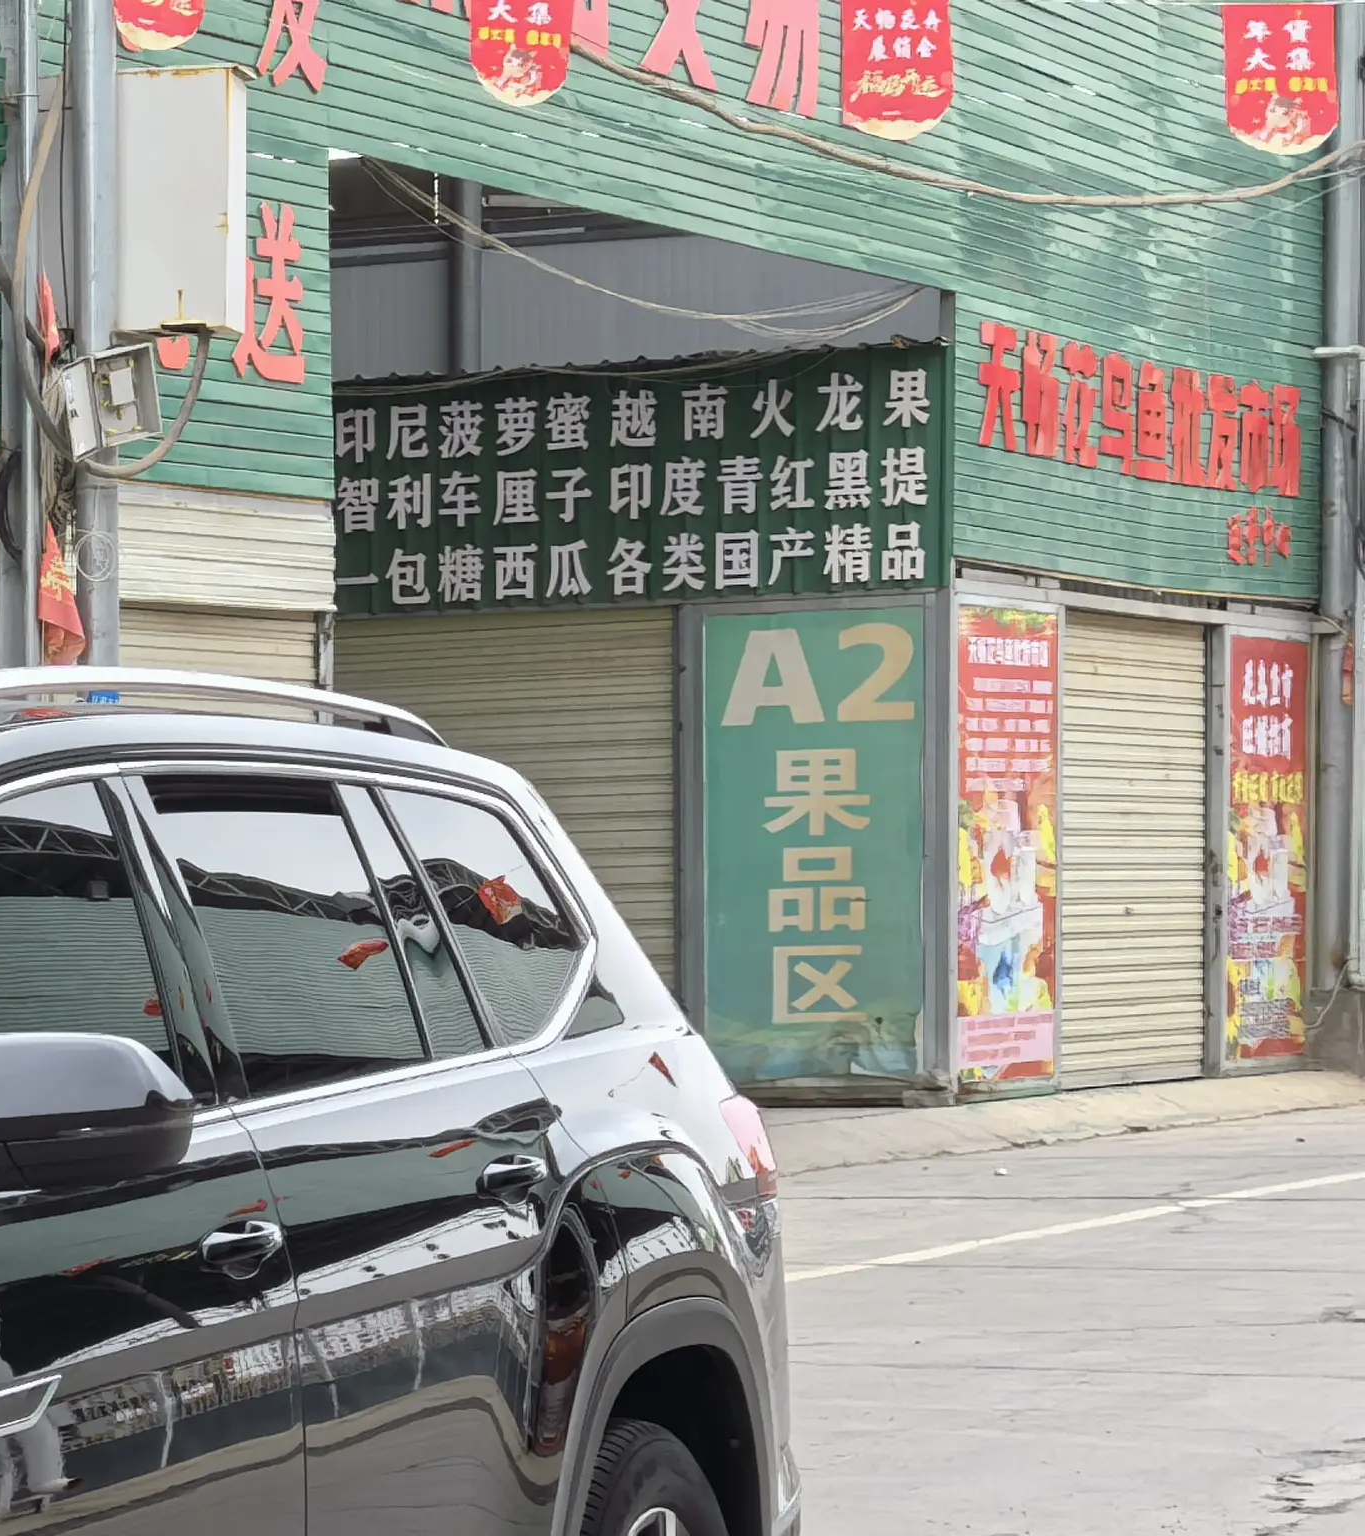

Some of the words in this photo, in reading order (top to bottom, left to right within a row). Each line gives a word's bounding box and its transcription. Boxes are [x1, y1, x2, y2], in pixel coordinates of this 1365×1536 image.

[721, 622, 915, 727] A2
[763, 748, 871, 1025] 果品区
